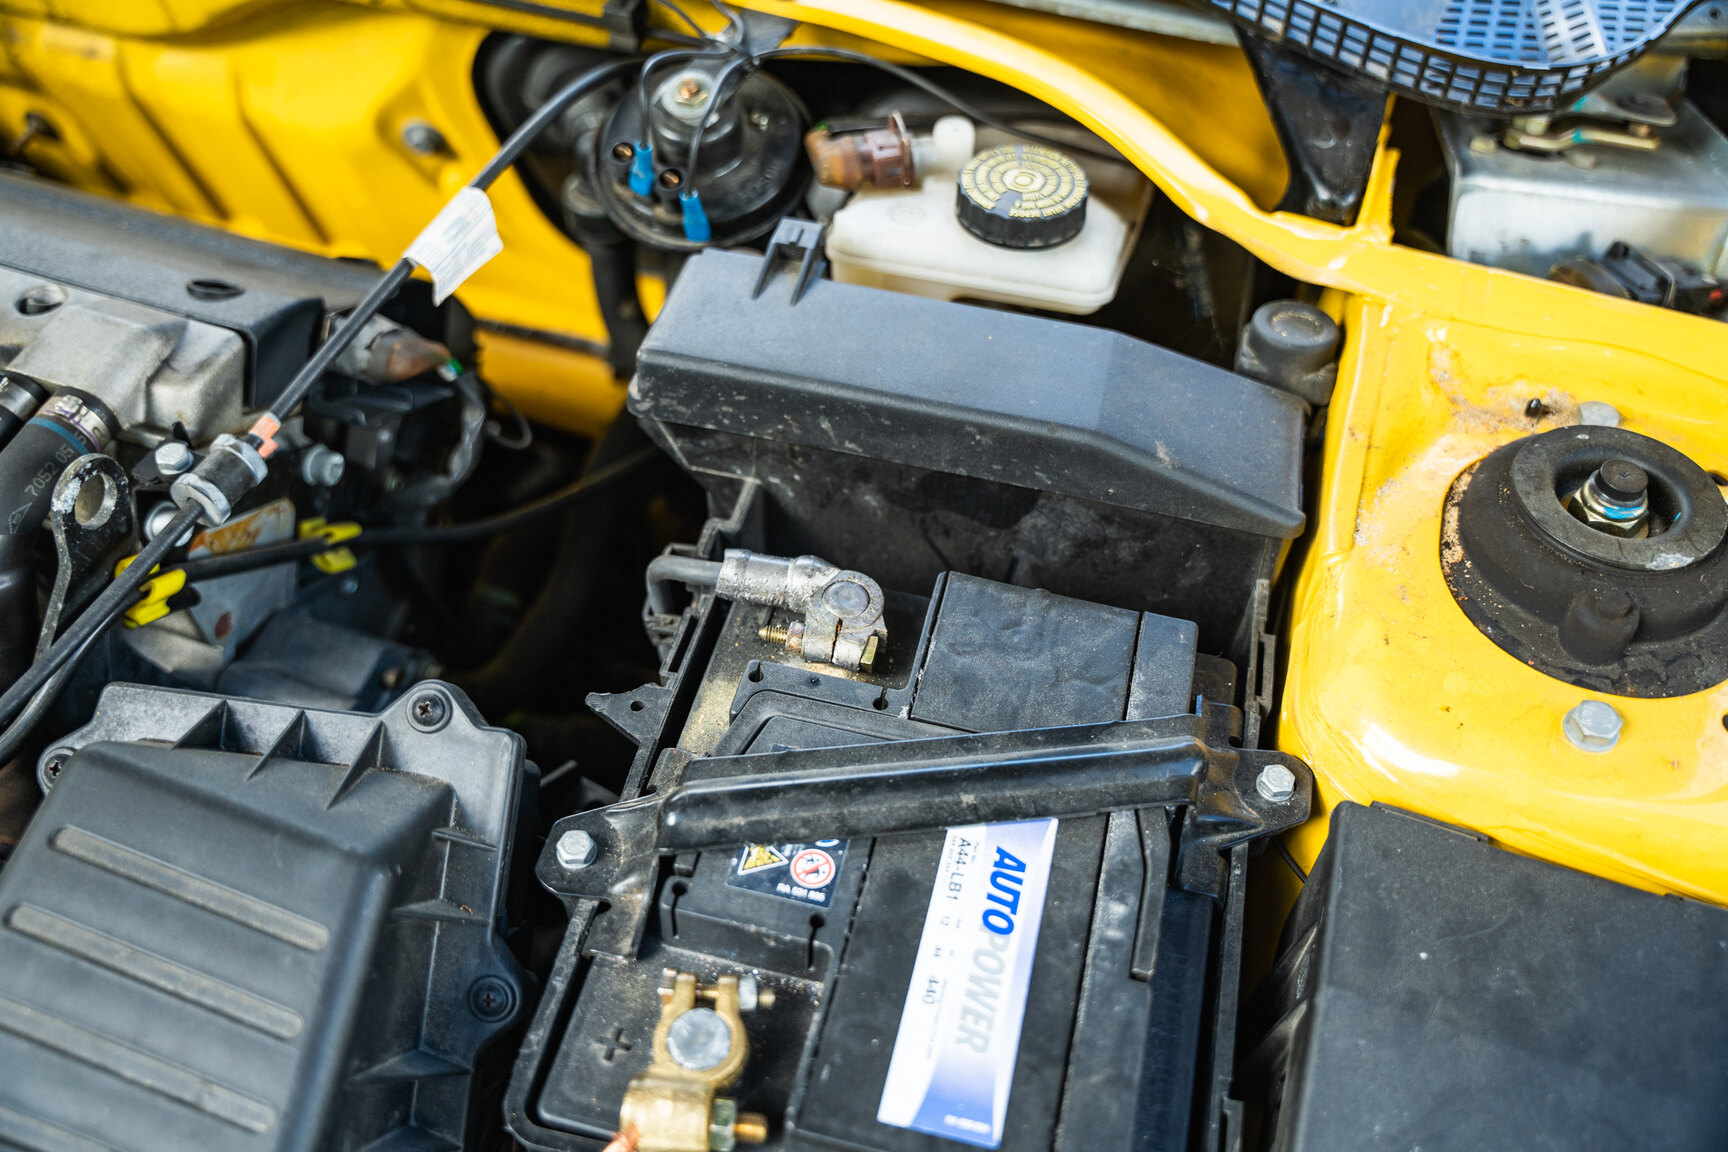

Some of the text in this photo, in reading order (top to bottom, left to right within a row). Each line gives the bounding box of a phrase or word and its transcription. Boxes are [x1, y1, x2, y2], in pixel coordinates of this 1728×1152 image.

[24, 461, 59, 497] 7052
[55, 443, 75, 464] 05
[946, 837, 972, 900] A44-LB1
